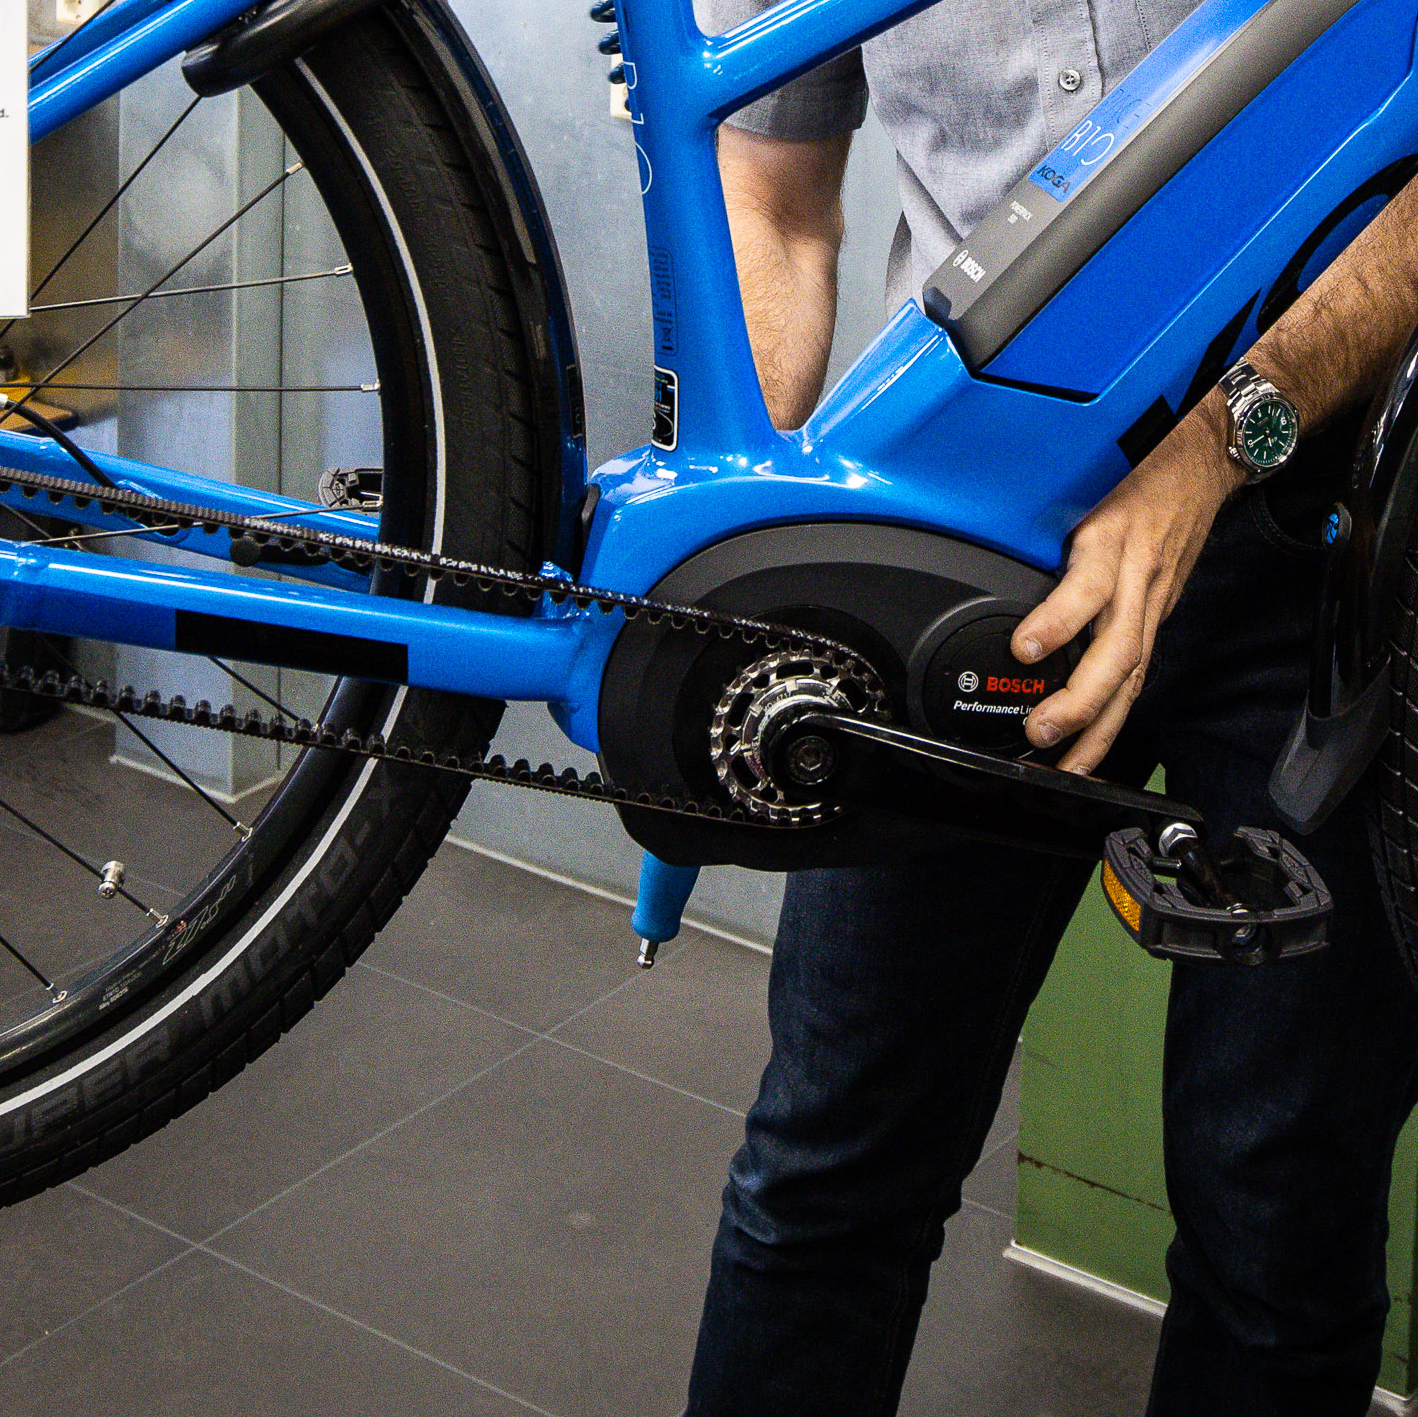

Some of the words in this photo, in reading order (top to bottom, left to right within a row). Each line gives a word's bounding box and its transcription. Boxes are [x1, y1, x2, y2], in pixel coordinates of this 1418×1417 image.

[1061, 119, 1115, 166] B10
[1036, 164, 1072, 194] KOGA
[960, 256, 987, 283] BOSCH
[986, 676, 1045, 694] BOSCH
[953, 700, 1020, 715] Performance
